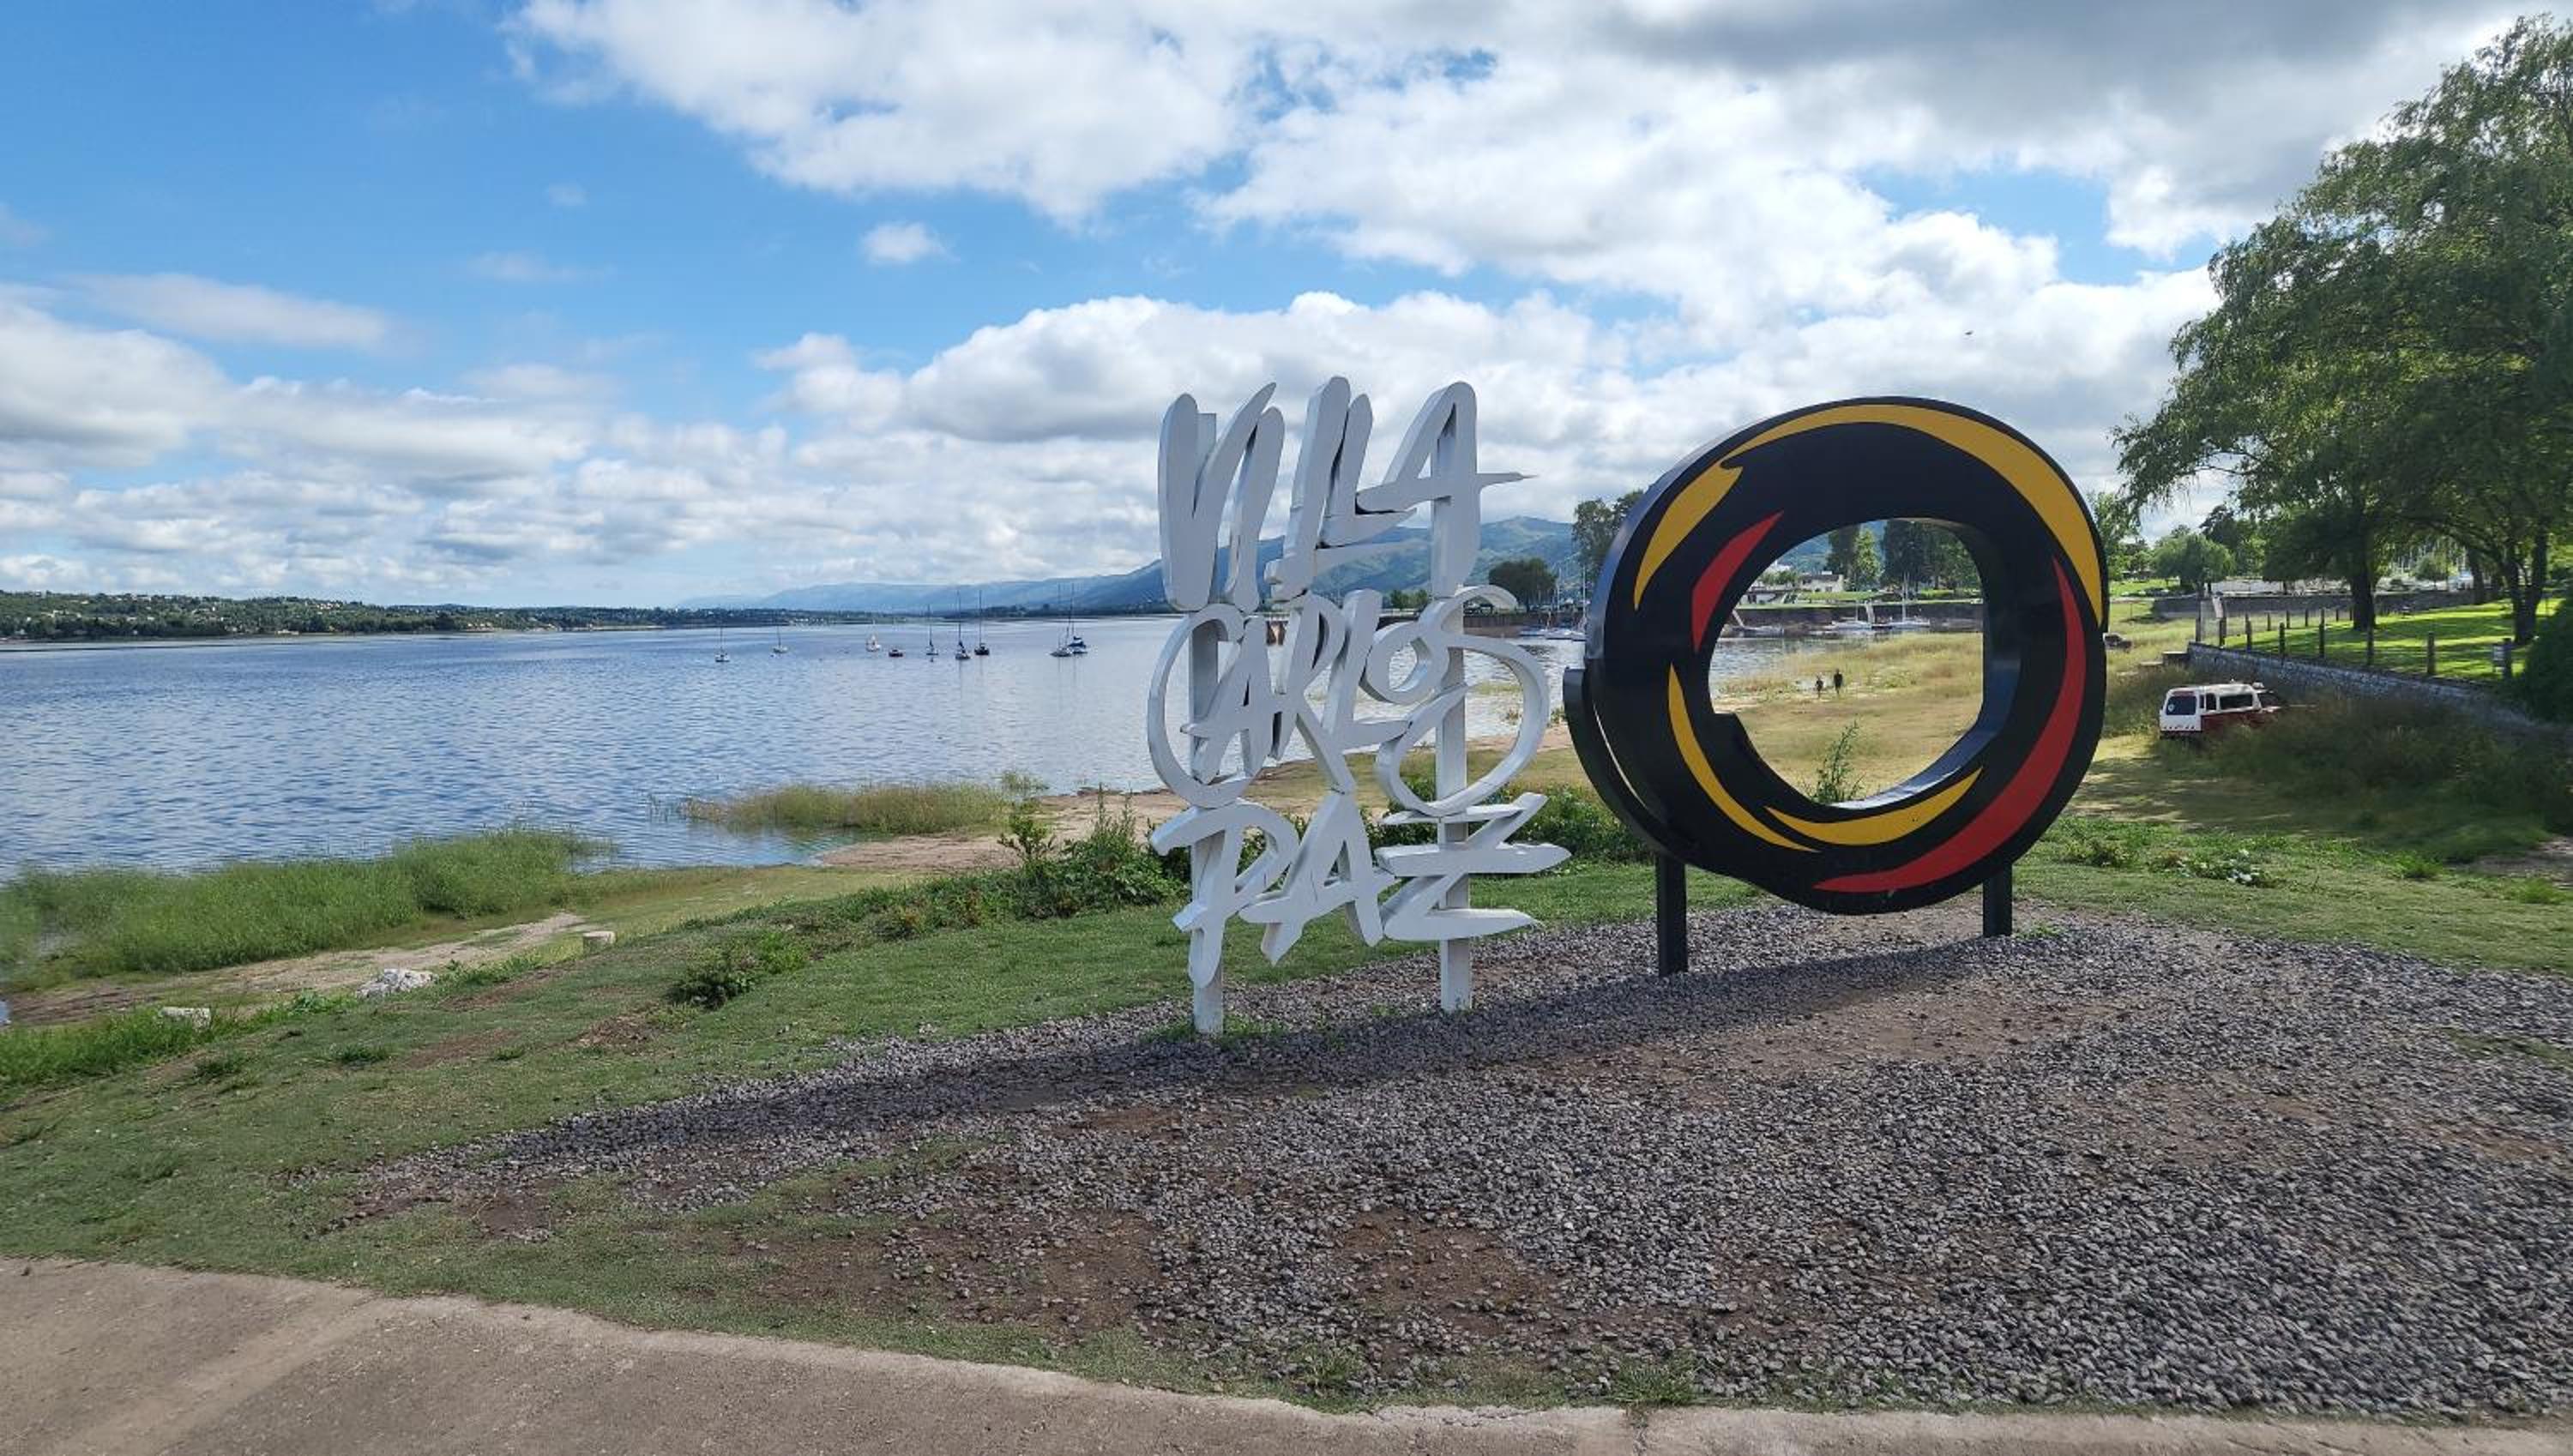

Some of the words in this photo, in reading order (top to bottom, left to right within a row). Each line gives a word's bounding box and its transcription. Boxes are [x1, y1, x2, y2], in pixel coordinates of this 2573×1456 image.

[1158, 376, 1538, 611] VILLA
[1148, 587, 1547, 815] CARLOS
[1149, 793, 1571, 988] PAZ
